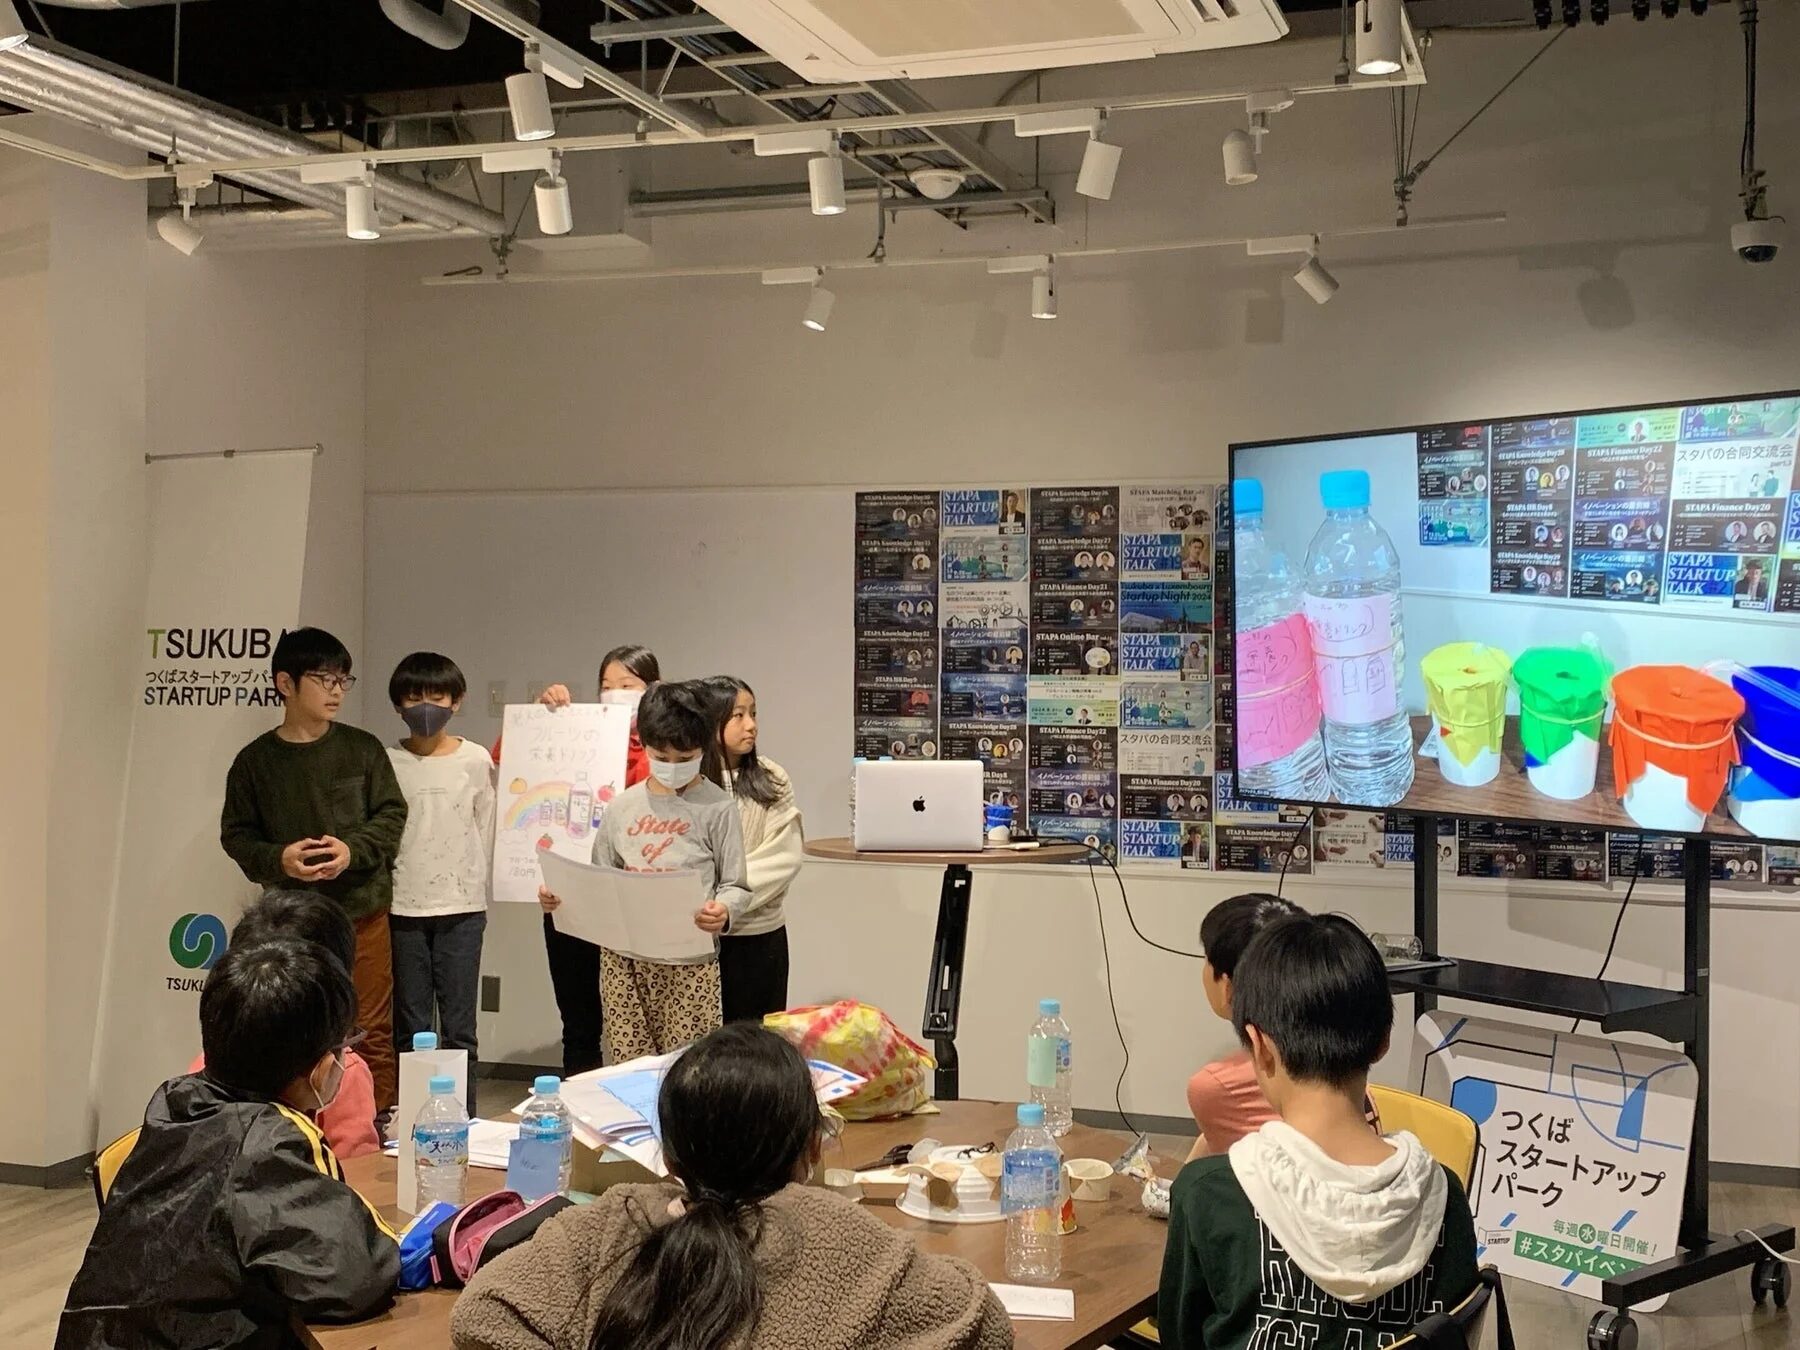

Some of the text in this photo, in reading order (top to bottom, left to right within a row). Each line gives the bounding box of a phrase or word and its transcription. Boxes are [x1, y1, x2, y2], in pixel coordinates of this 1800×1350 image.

[1610, 447, 1637, 456] Finance
[945, 490, 980, 501] STAPA
[945, 502, 998, 513] STARTUP
[1745, 503, 1771, 513] Day20
[946, 514, 976, 525] TALK
[1124, 535, 1162, 546] STAPA
[1124, 546, 1181, 558] STARTUP
[1125, 559, 1157, 570] TALK
[1670, 554, 1714, 566] STAPA
[1669, 566, 1736, 582] STARTUP
[1668, 582, 1706, 594] TALK
[1120, 592, 1159, 603] Startup
[1161, 591, 1190, 604] Night
[148, 628, 288, 658] TSUKUB
[1122, 634, 1160, 646] STAPA
[1122, 646, 1181, 658] STARTUP
[1124, 659, 1156, 670] TALK
[144, 686, 231, 706] STARTUP
[1180, 779, 1201, 788] Day20
[1220, 800, 1252, 811] TALK
[628, 814, 691, 836] State
[1122, 821, 1160, 832] STAPA
[1123, 832, 1181, 844] STARTUP
[642, 837, 674, 864] of
[1124, 845, 1157, 857] TALK
[1386, 844, 1414, 852] START
[1386, 852, 1412, 861] TALK
[1501, 1110, 1574, 1144] つくば
[1496, 1140, 1666, 1198] スタートアップ
[1491, 1172, 1564, 1208] パーク
[1488, 1237, 1510, 1245] STARTUP
